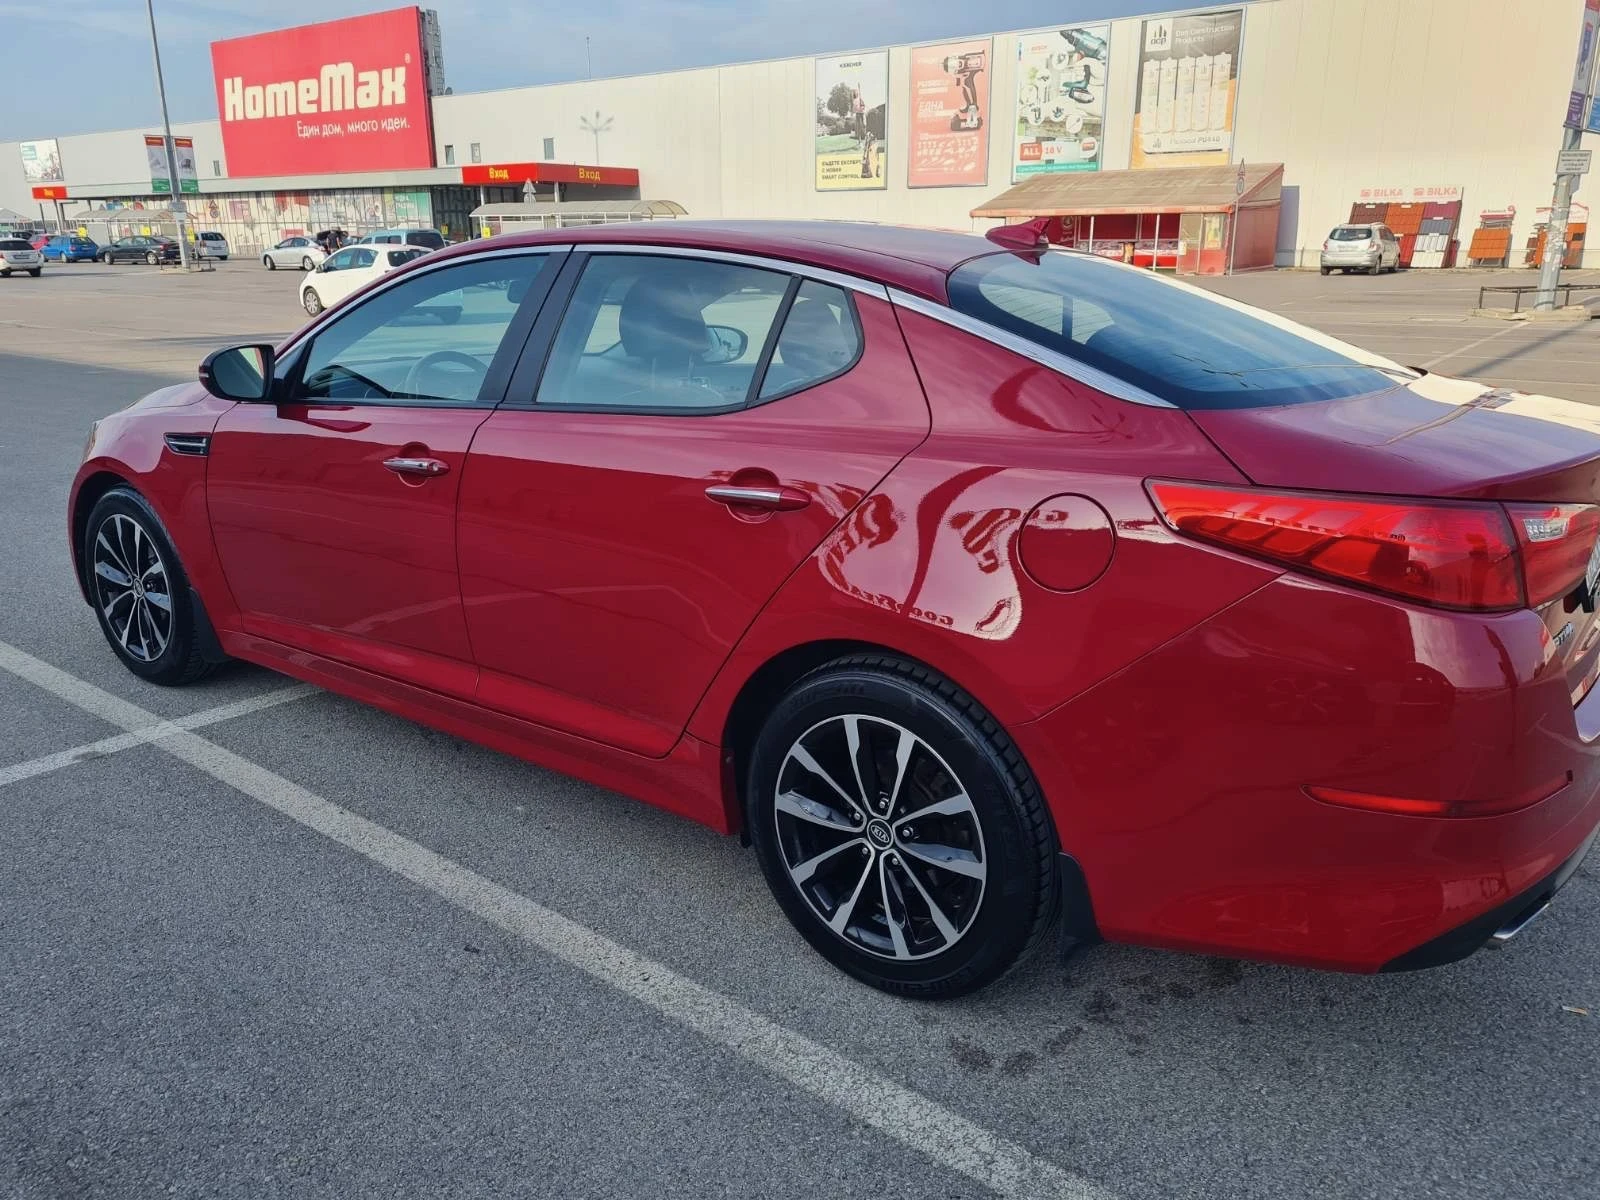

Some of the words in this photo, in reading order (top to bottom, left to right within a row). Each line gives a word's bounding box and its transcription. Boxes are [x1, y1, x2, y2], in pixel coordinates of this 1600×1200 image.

[223, 61, 406, 122] HomeMax
[296, 120, 320, 138] Един
[322, 122, 345, 137] дом,
[347, 118, 379, 133] много
[381, 115, 411, 132] идеи.
[1023, 147, 1041, 156] ALL
[488, 167, 509, 180] Вход
[578, 167, 601, 180] Вход
[1373, 188, 1403, 197] BILKA
[1427, 187, 1458, 196] BILKA
